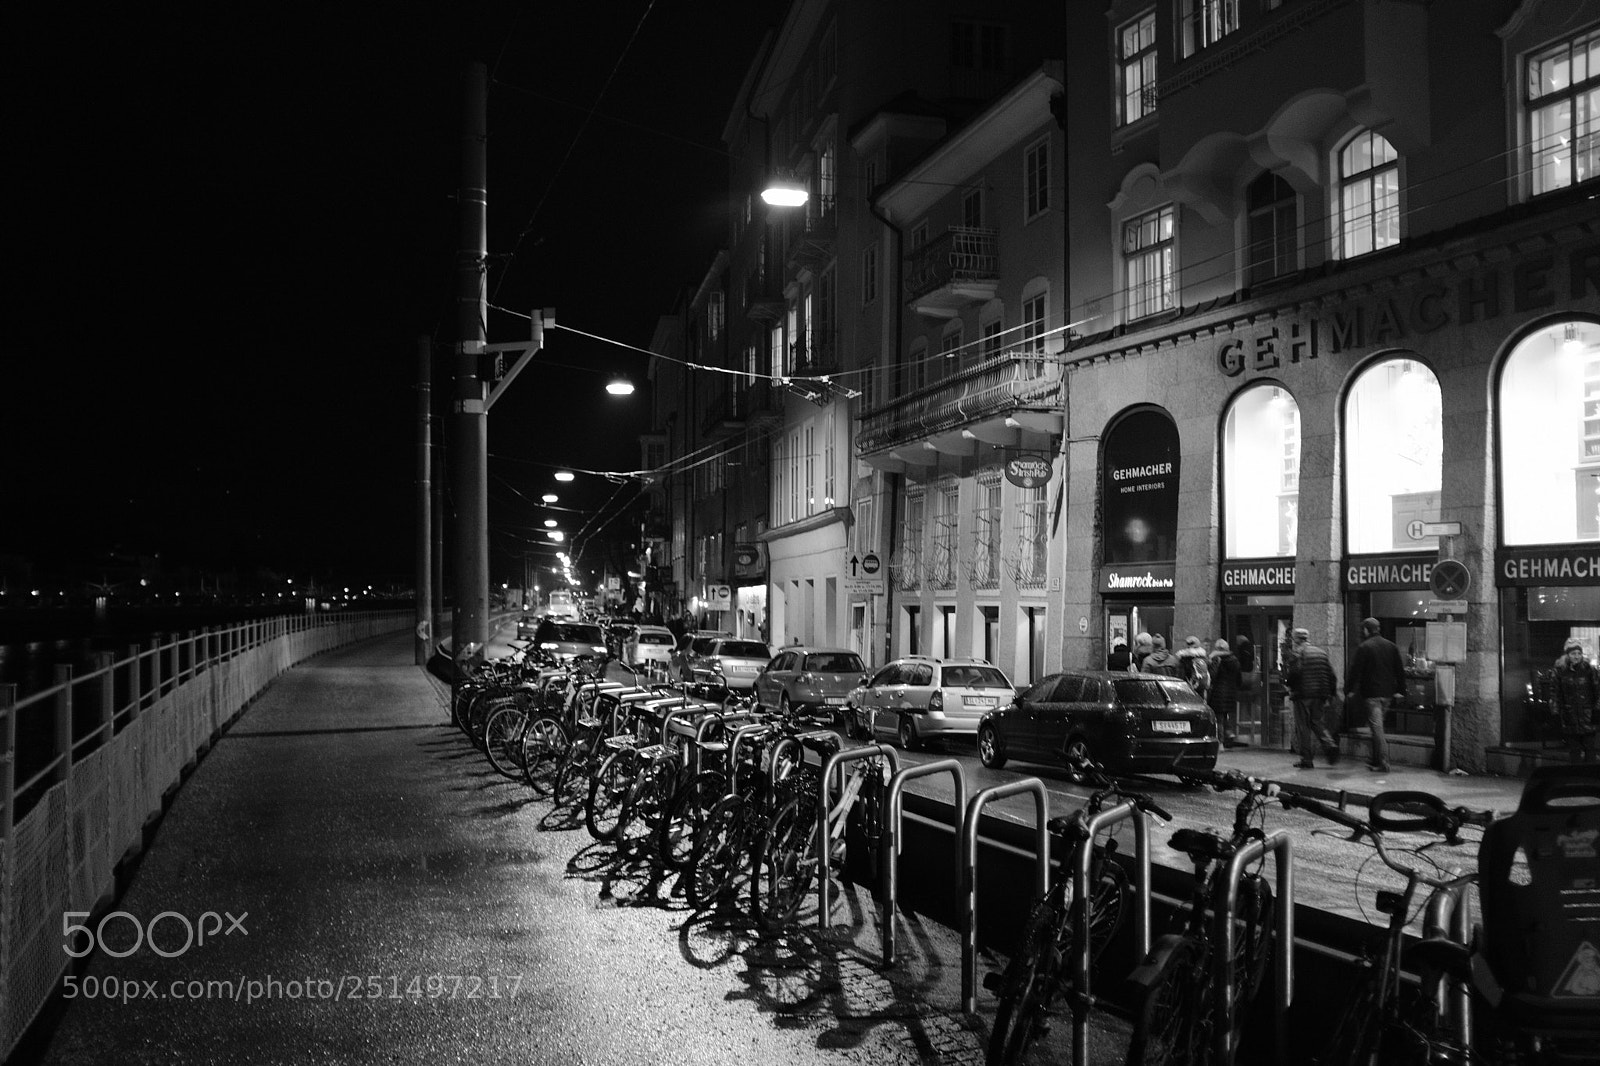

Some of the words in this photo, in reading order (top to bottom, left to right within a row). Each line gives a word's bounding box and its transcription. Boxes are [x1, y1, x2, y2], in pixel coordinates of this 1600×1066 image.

[1113, 462, 1172, 481] GEHMACHER
[1120, 485, 1135, 494] HOME
[1136, 481, 1165, 492] INTERIORS
[1412, 523, 1423, 536] H
[1347, 563, 1437, 585] GEHMACHE
[1504, 556, 1600, 578] GEHMACH
[1107, 571, 1153, 589] Shamrock
